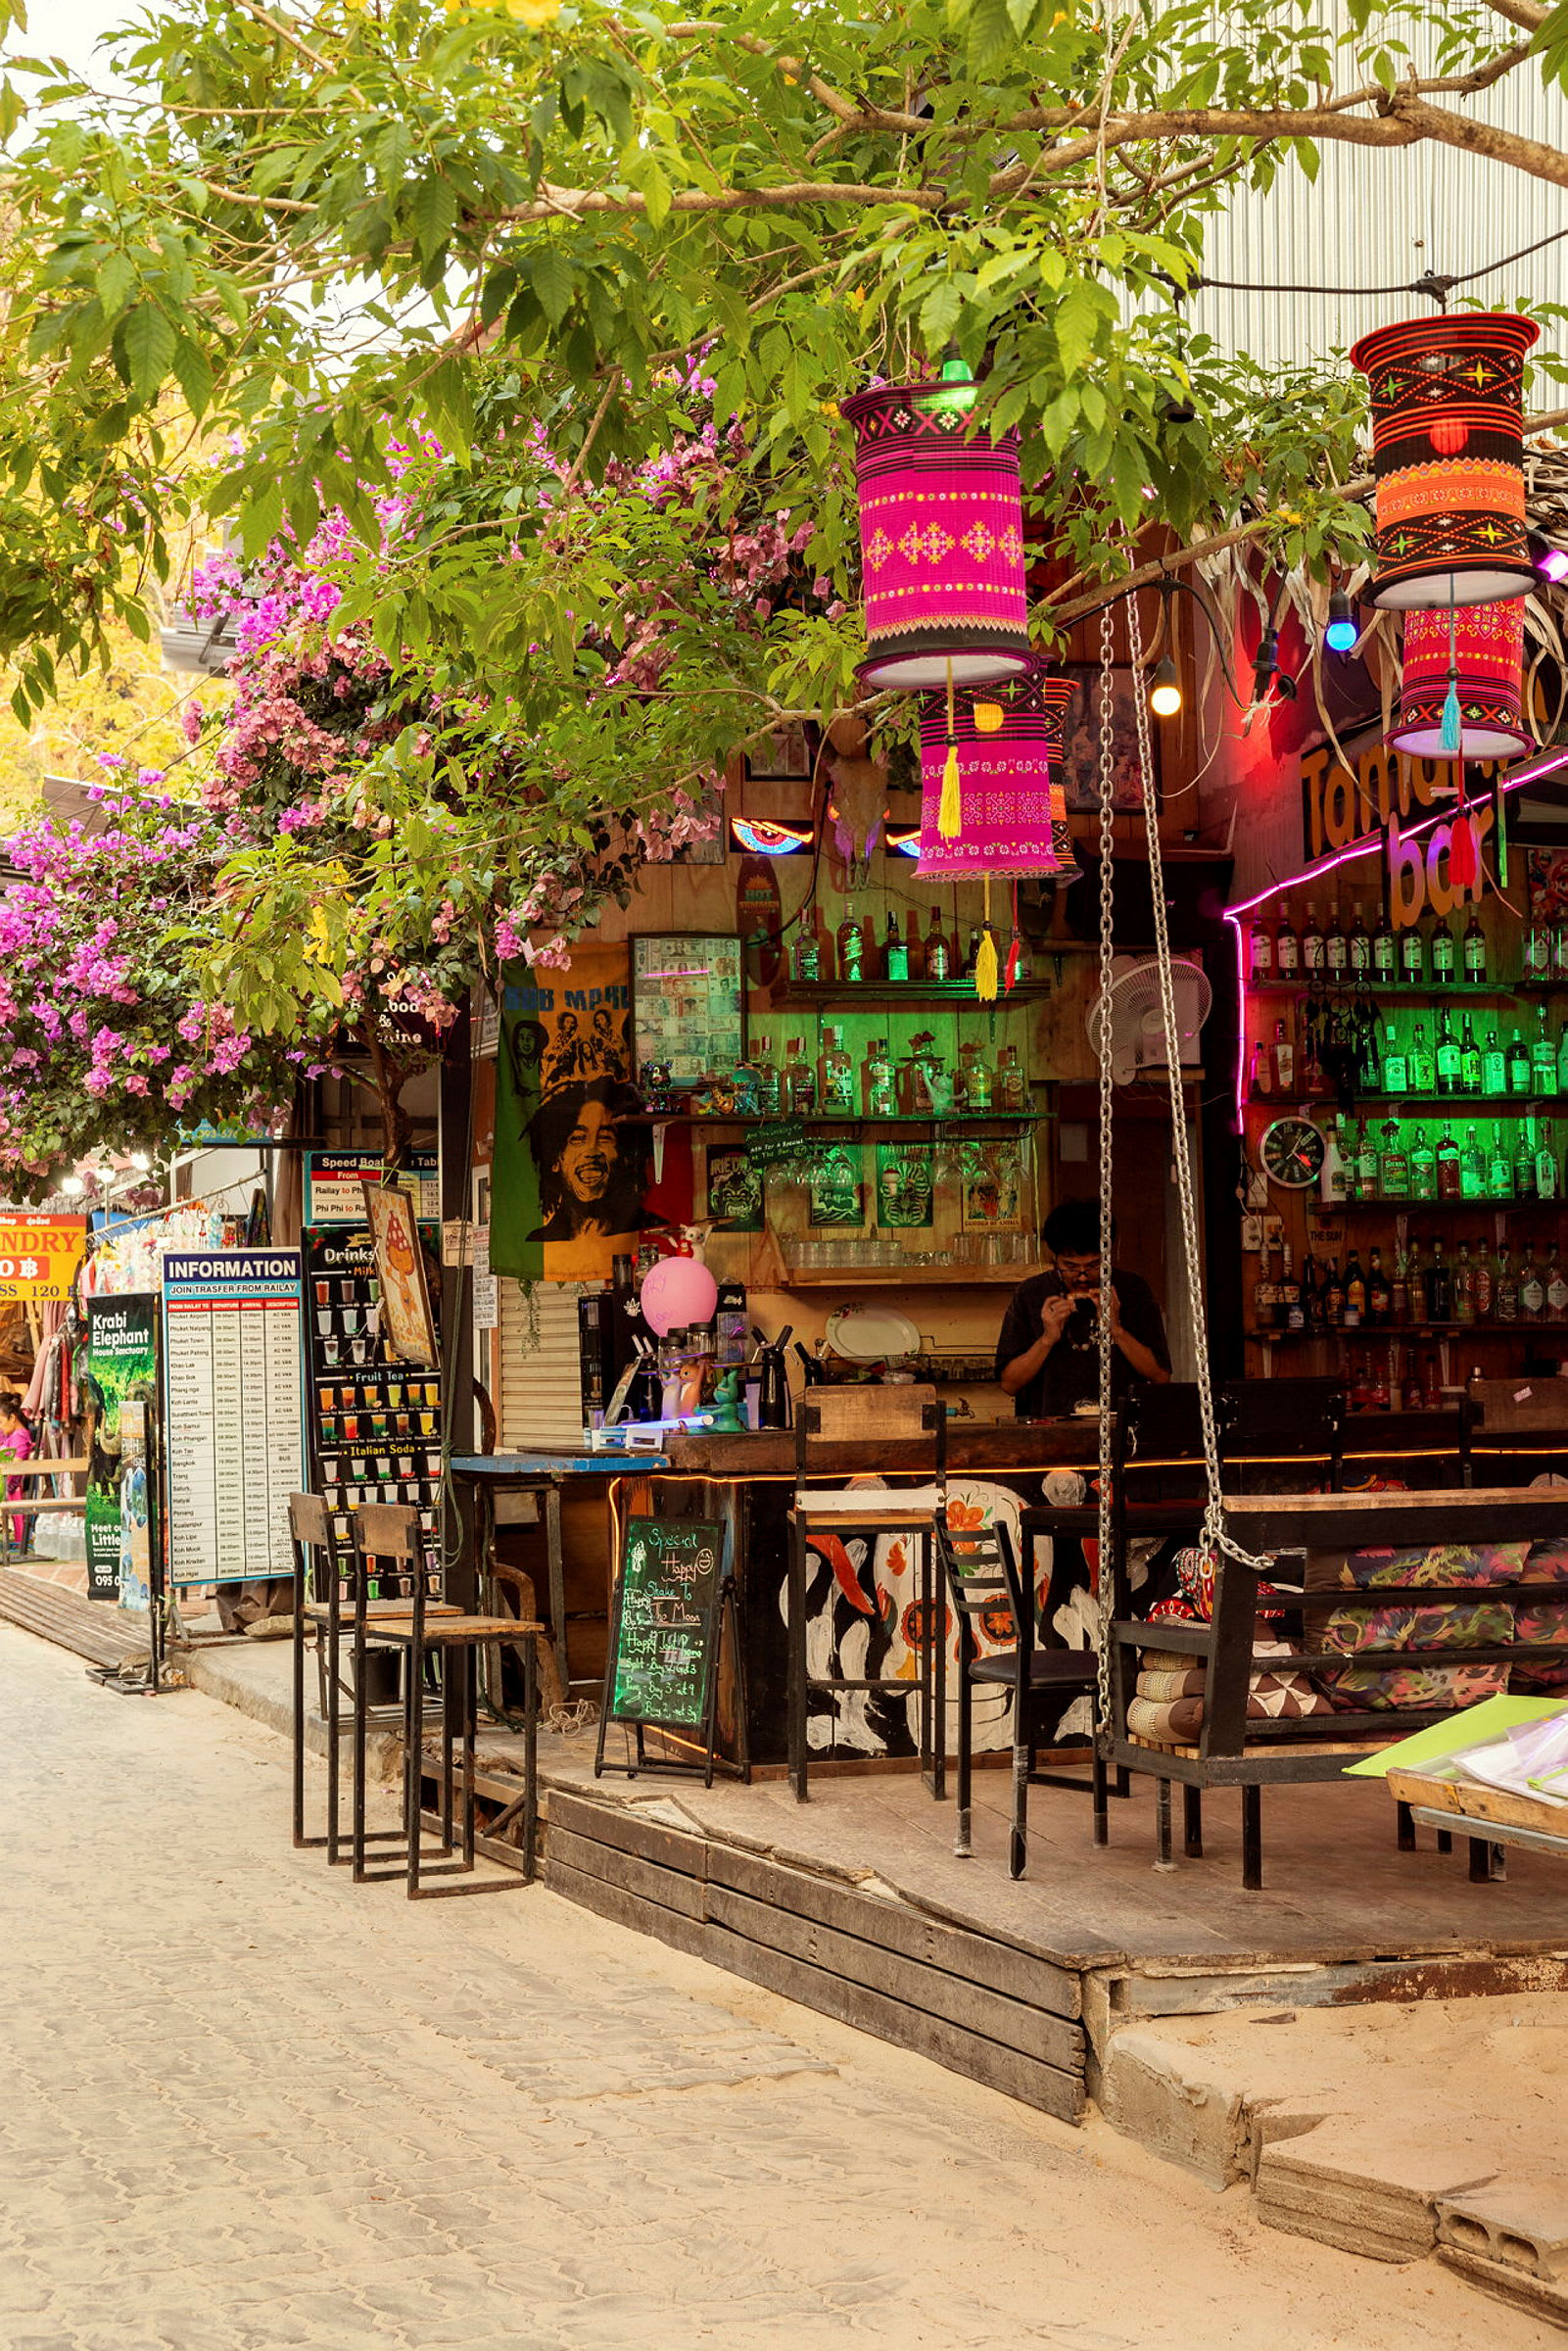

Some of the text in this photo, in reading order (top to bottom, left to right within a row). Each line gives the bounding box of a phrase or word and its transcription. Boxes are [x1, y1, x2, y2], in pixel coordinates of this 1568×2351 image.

[1389, 805, 1494, 931] bar
[378, 1014, 392, 1028] &
[321, 1157, 356, 1170] Speed
[315, 1186, 340, 1195] Railay
[0, 1231, 79, 1252] NDRY
[1309, 1230, 1324, 1241] THE
[324, 1248, 376, 1263] Drinks
[168, 1260, 296, 1278] INFORMATION
[354, 1267, 376, 1276] Milk
[32, 1285, 60, 1297] 120
[170, 1283, 296, 1294] JOIN TRASFER FROM RAILAY
[93, 1311, 126, 1329] Krabi
[92, 1328, 149, 1349] Elephant
[115, 1347, 149, 1356] Sanctuary
[356, 1371, 404, 1382] Fruit Tea
[350, 1444, 415, 1457] Italian Soda
[91, 1524, 113, 1534] Meet
[92, 1534, 121, 1546] Little
[648, 1528, 698, 1559] Special
[661, 1551, 697, 1583] Happy
[95, 1575, 115, 1587] 095
[644, 1580, 692, 1601] Shake To
[673, 1603, 701, 1622] Moon
[626, 1631, 656, 1655] Happy
